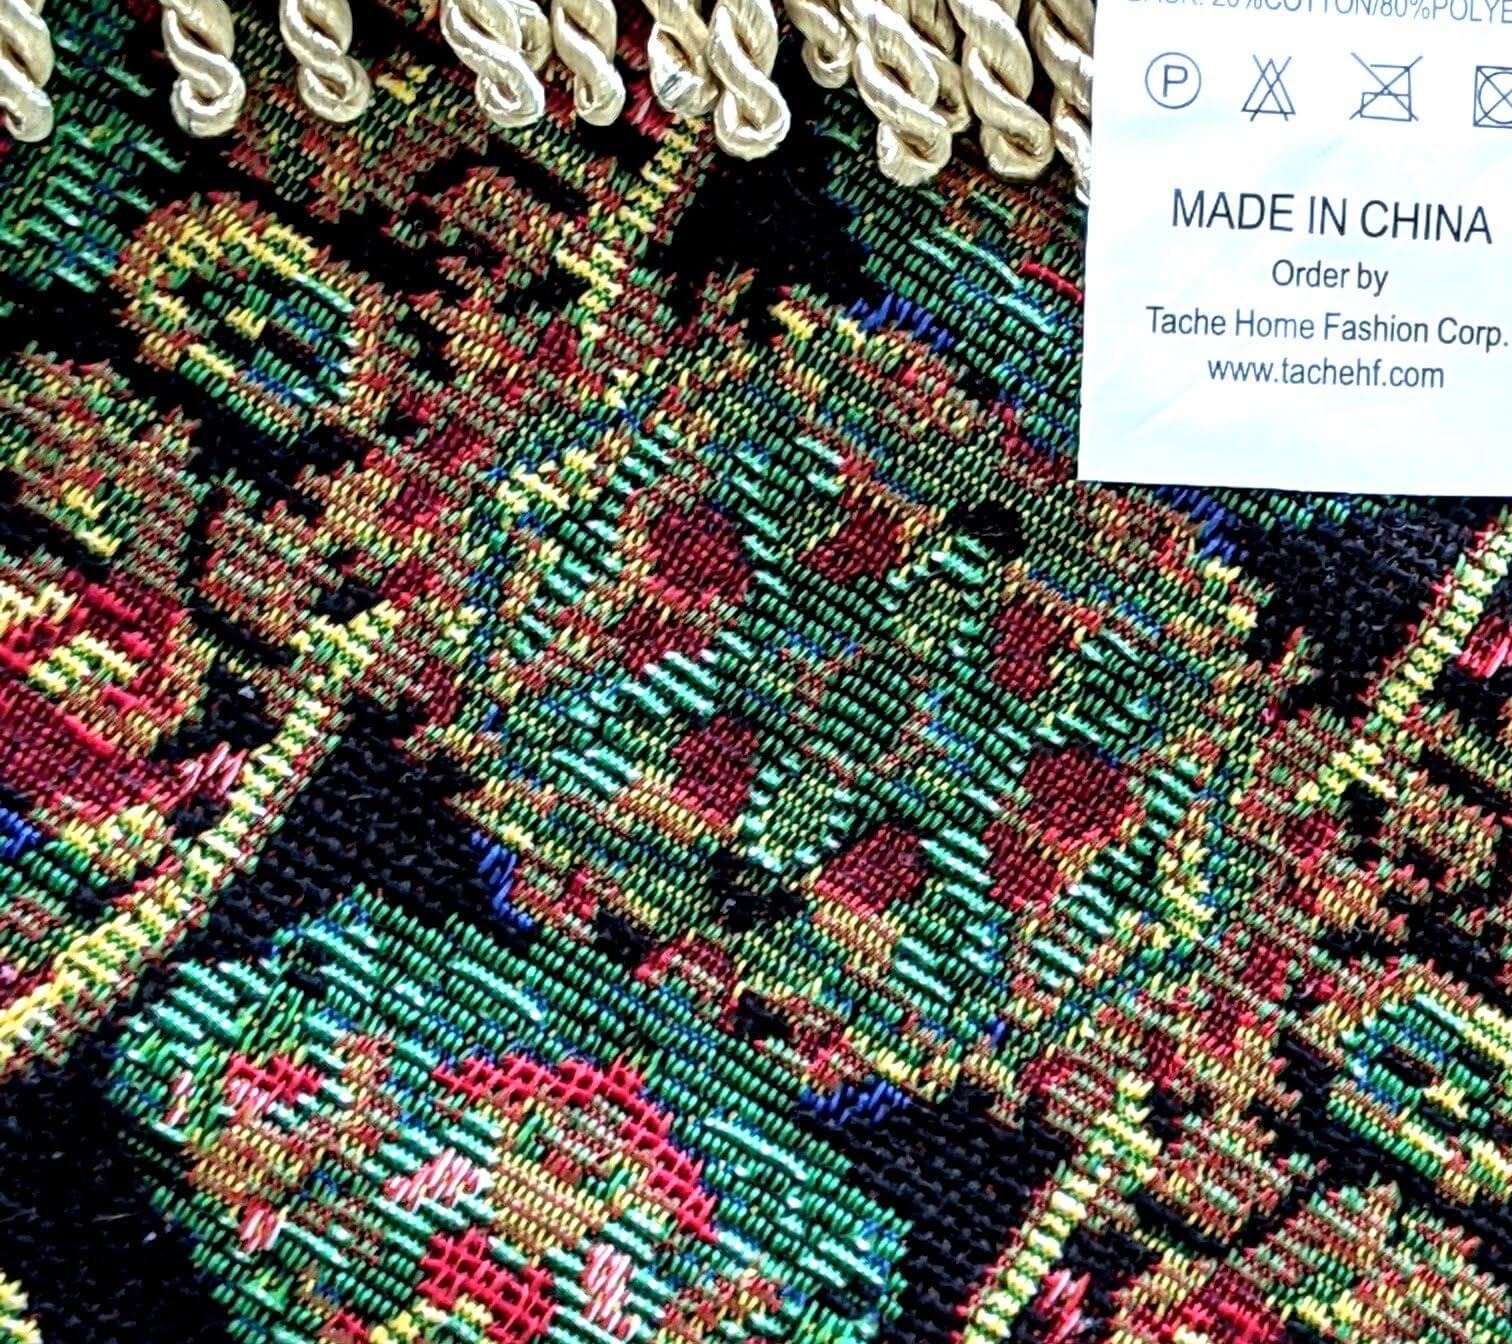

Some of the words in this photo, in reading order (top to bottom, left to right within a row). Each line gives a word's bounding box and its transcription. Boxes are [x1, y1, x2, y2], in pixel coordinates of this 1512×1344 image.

[1172, 188, 1295, 232] MADE
[1308, 196, 1347, 237] IN
[1360, 199, 1493, 245] CHINA
[1272, 259, 1350, 289] Order
[1357, 262, 1389, 297] by
[1146, 306, 1226, 336] Tache
[1235, 309, 1315, 340] Home
[1324, 312, 1428, 343] Fashion
[1437, 317, 1509, 353] Corp.
[1208, 358, 1444, 388] www.tachehf.com
